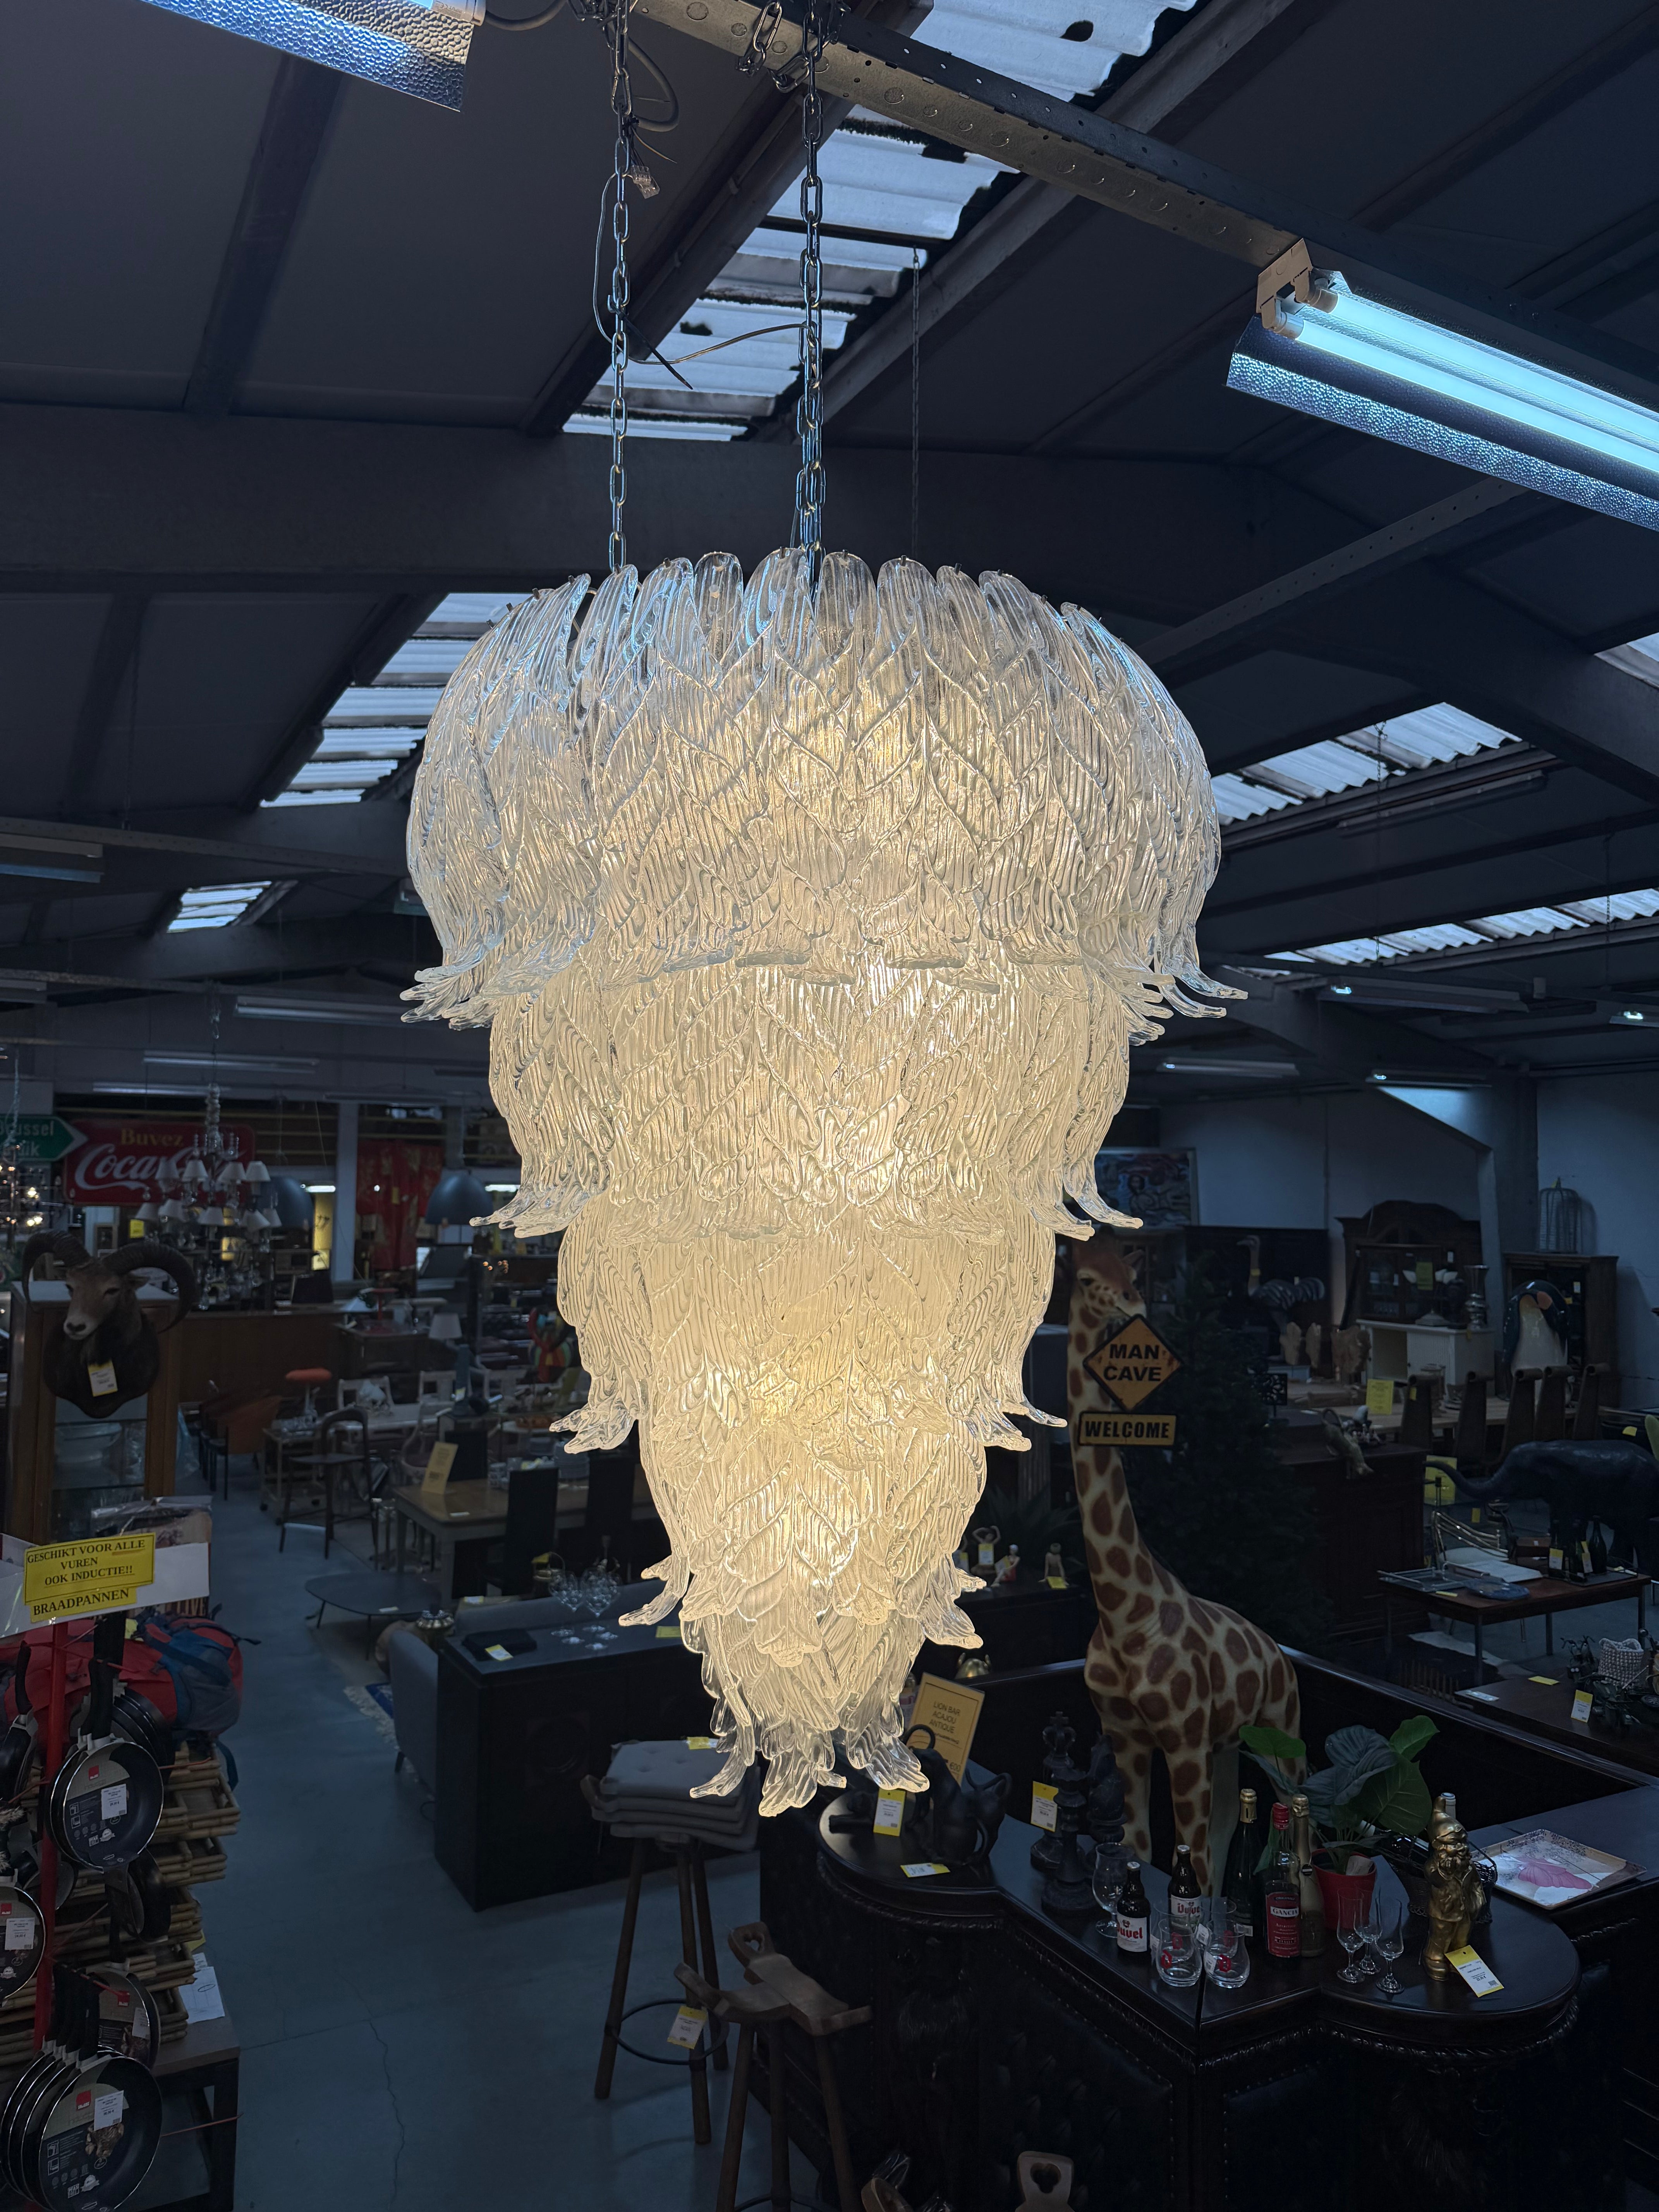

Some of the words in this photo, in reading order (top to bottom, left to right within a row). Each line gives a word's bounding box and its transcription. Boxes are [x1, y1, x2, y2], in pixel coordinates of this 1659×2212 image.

[120, 1128, 184, 1147] Buvez
[1109, 1344, 1159, 1360] MAN
[1103, 1366, 1161, 1381] CAVE
[1084, 1421, 1169, 1438] WELCOME
[27, 1547, 77, 1563] GESCHIKT
[79, 1542, 112, 1554] VOOR
[115, 1540, 145, 1550] ALLE
[60, 1557, 98, 1570] VUREN
[45, 1573, 68, 1585] OOK
[71, 1565, 132, 1581] INDUCTIE!!
[33, 1588, 129, 1616] BRAADPANNEN
[933, 1700, 947, 1711] LION
[948, 1706, 960, 1716] BAR
[933, 1711, 957, 1724] ACAJOU
[930, 1719, 955, 1734] ANTIQUE
[1177, 1903, 1200, 1915] Duve
